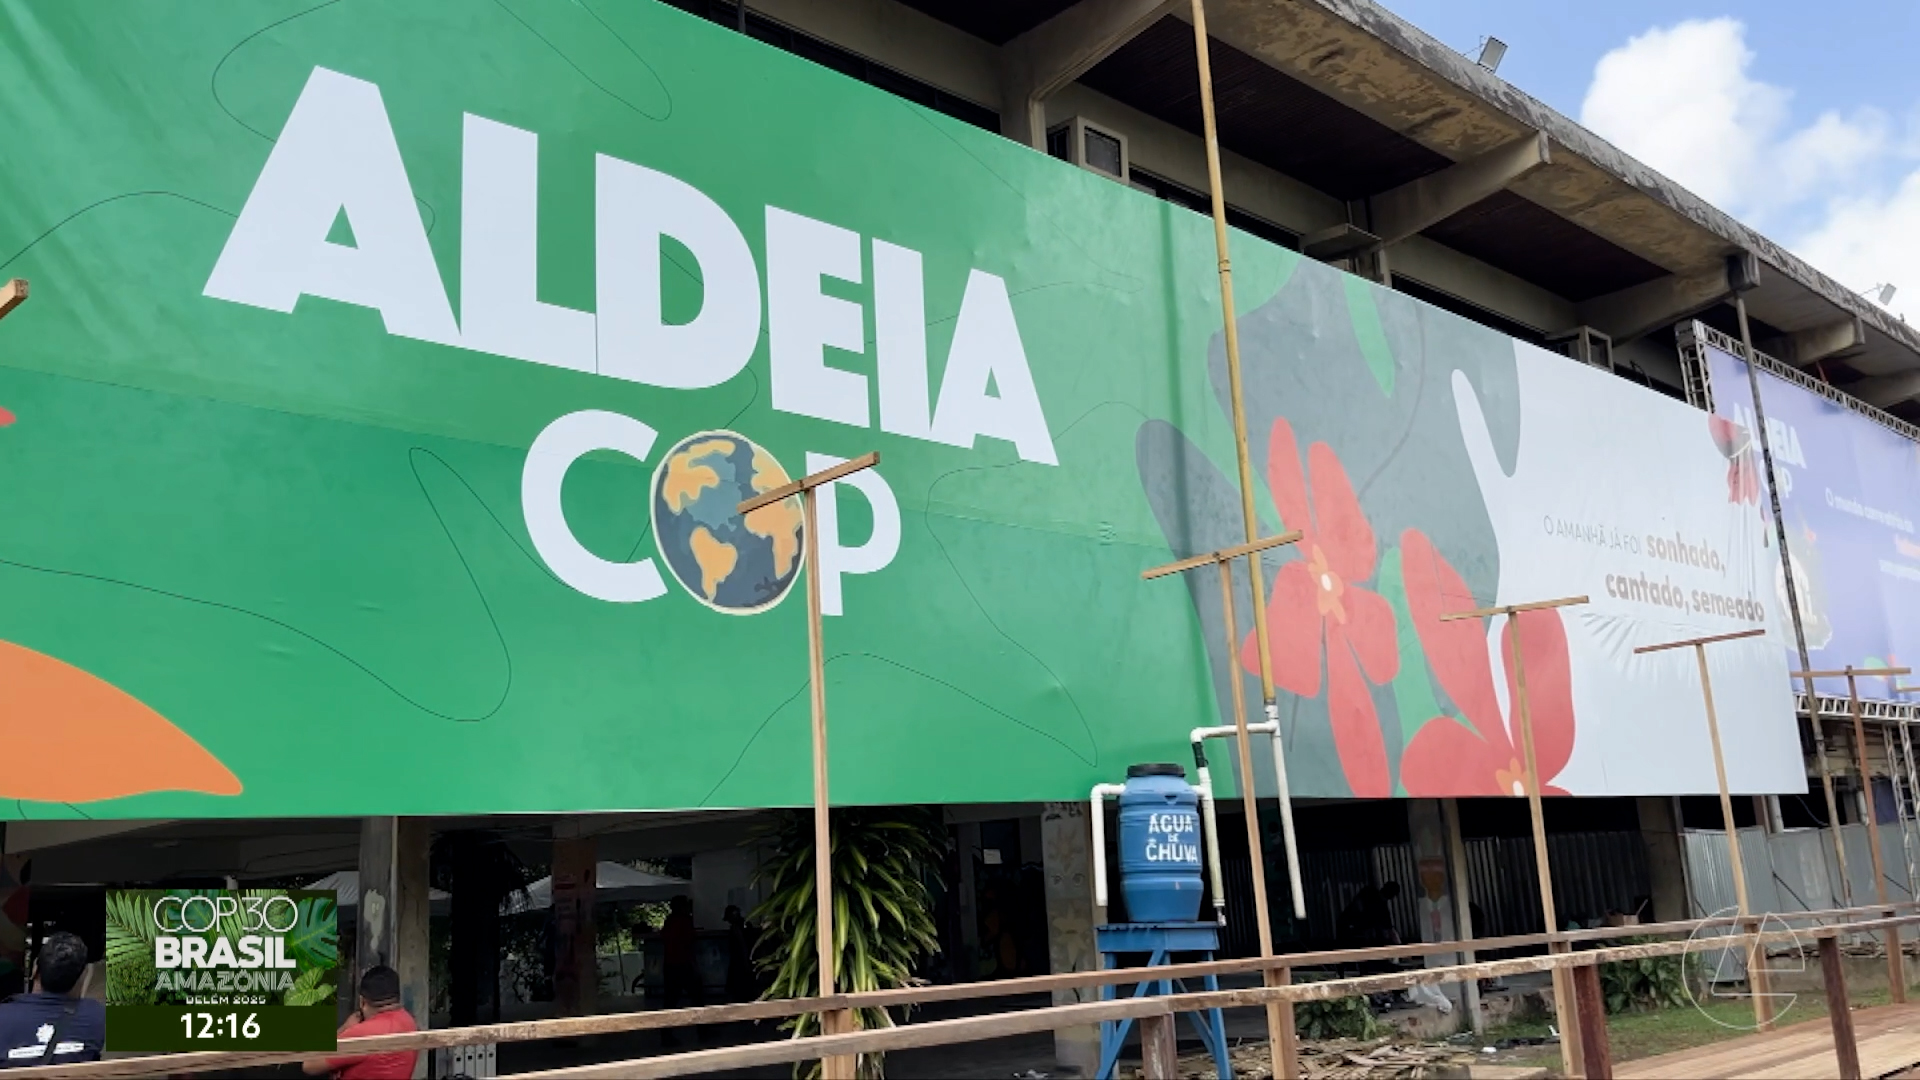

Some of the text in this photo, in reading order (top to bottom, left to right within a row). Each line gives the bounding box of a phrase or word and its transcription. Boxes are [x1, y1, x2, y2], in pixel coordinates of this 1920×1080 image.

[201, 65, 1059, 467] ALDEIA
[1543, 515, 1727, 578] O AMANHÃ JÁ FOI sonhado,
[1605, 571, 1765, 622] cantado, semeado
[1146, 842, 1198, 863] CHUVA
